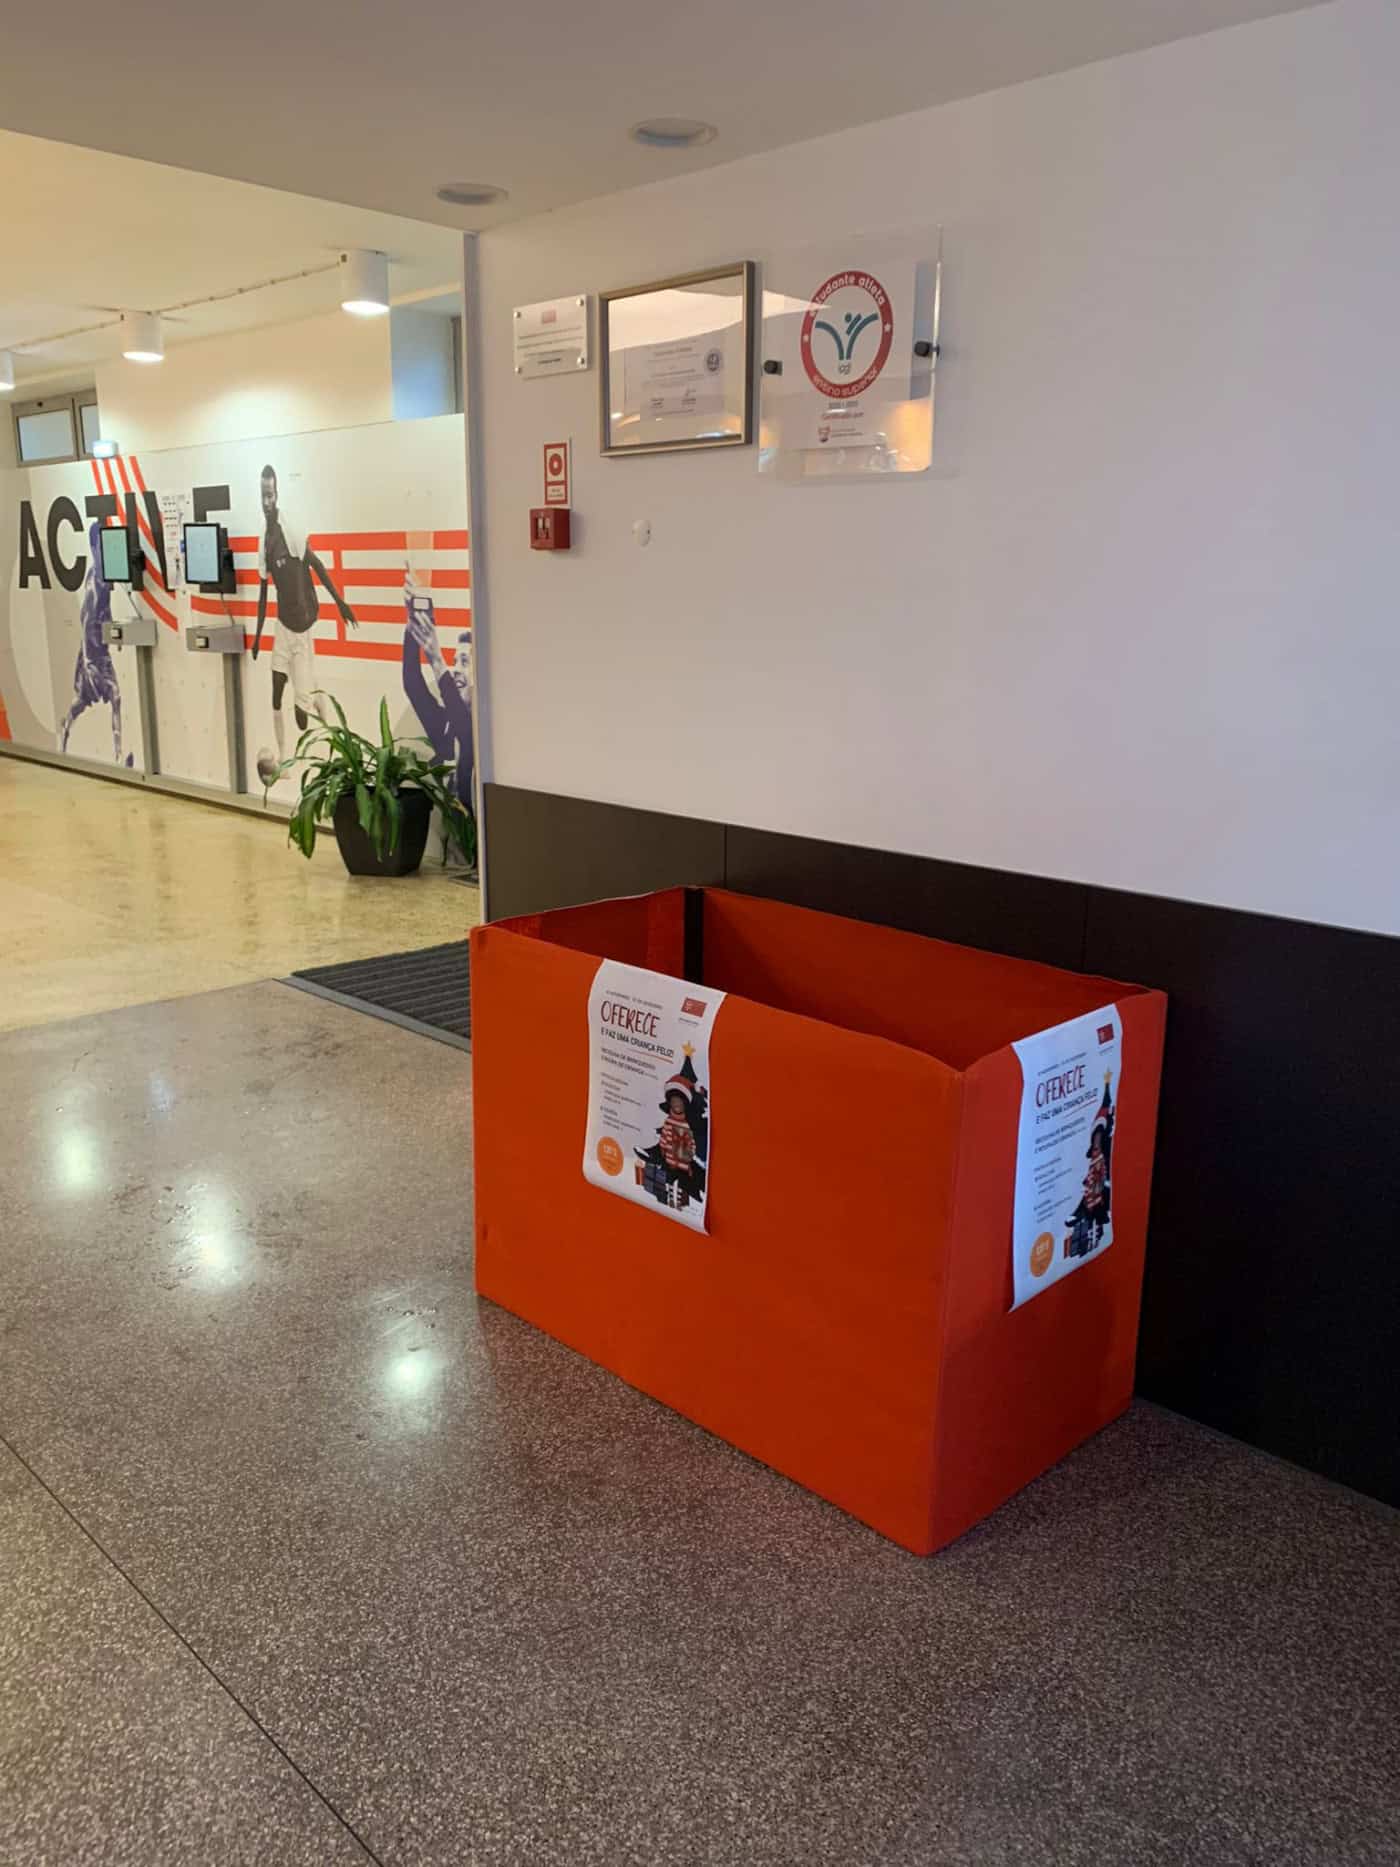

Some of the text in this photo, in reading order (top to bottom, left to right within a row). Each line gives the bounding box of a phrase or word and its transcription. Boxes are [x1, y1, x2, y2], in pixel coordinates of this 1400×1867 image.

[601, 1000, 661, 1038] OFERECE
[617, 1032, 629, 1043] UMA
[630, 1037, 655, 1052] CRIANÇA
[1036, 1064, 1087, 1108] OFERECE
